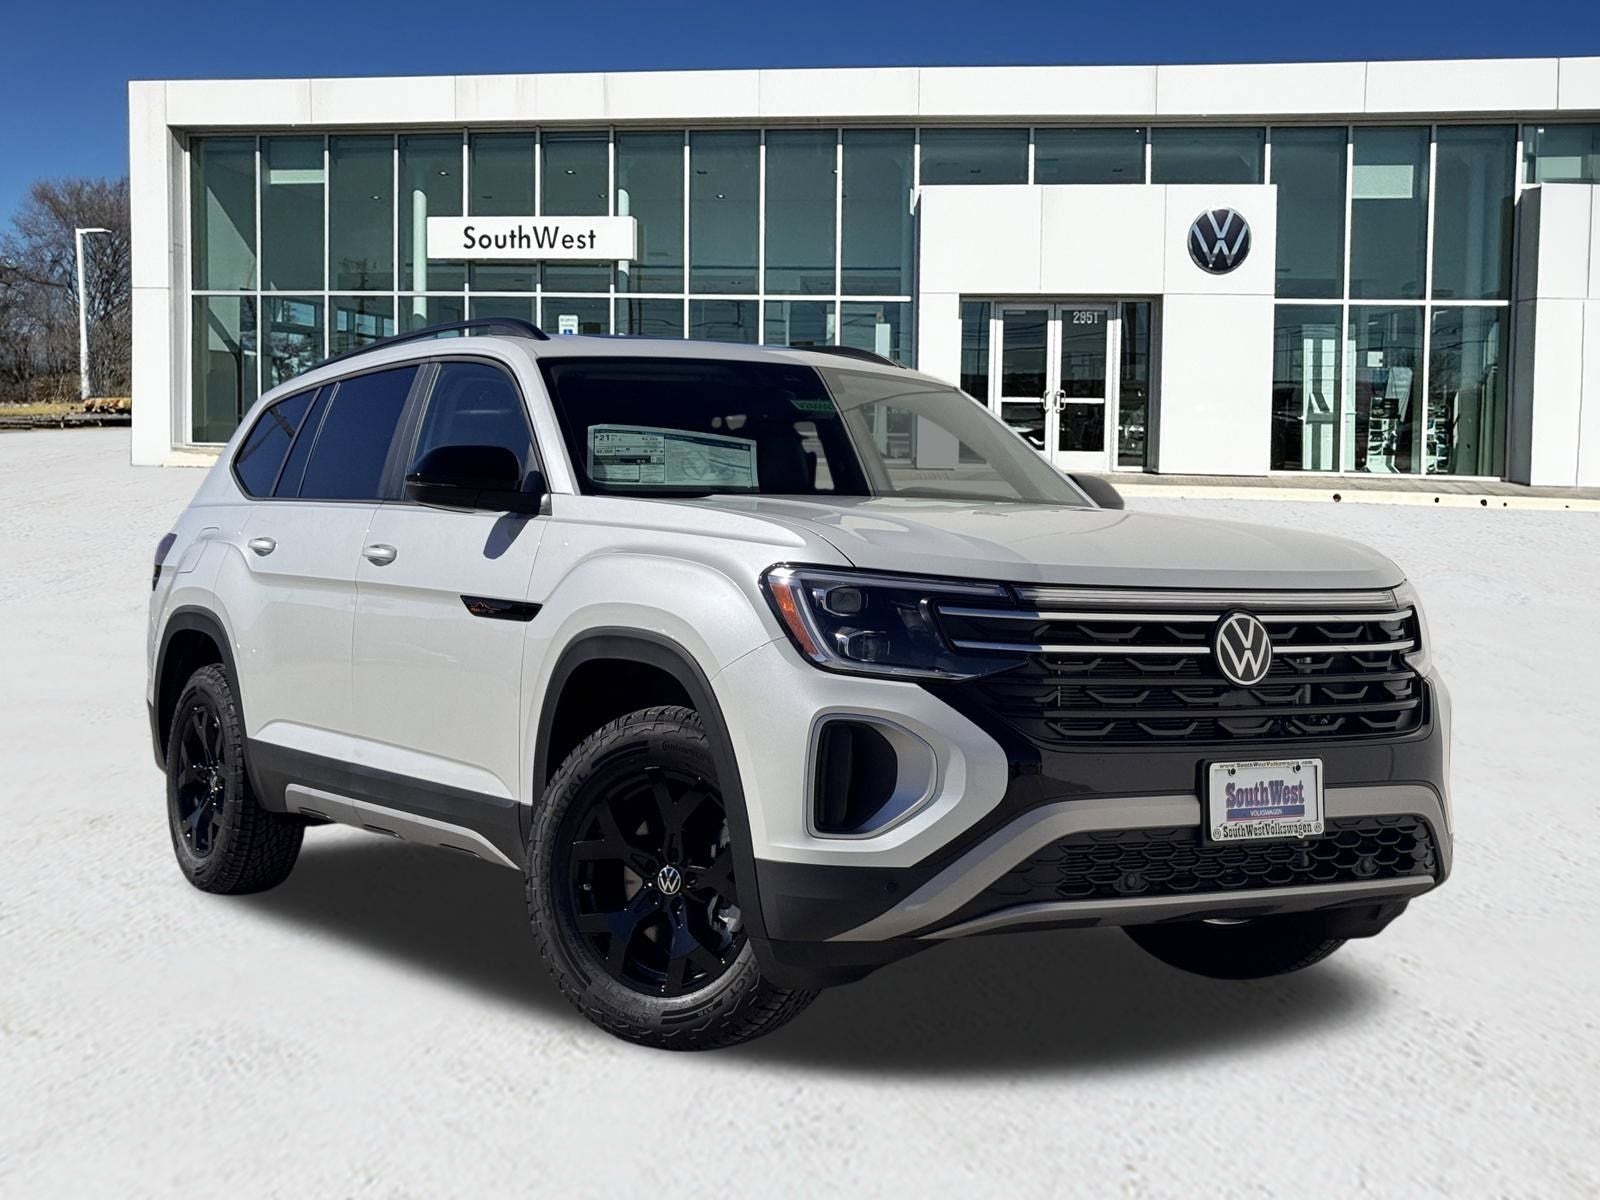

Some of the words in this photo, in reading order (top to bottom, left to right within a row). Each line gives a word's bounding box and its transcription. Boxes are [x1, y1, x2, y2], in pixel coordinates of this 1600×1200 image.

[463, 225, 596, 249] SouthWest
[1073, 311, 1098, 324] 2951
[1217, 613, 1271, 685] VW
[1225, 780, 1304, 808] SouthWest
[1250, 808, 1282, 816] VOLKSWAGEN
[1223, 822, 1312, 838] SouthWestVolkswagen
